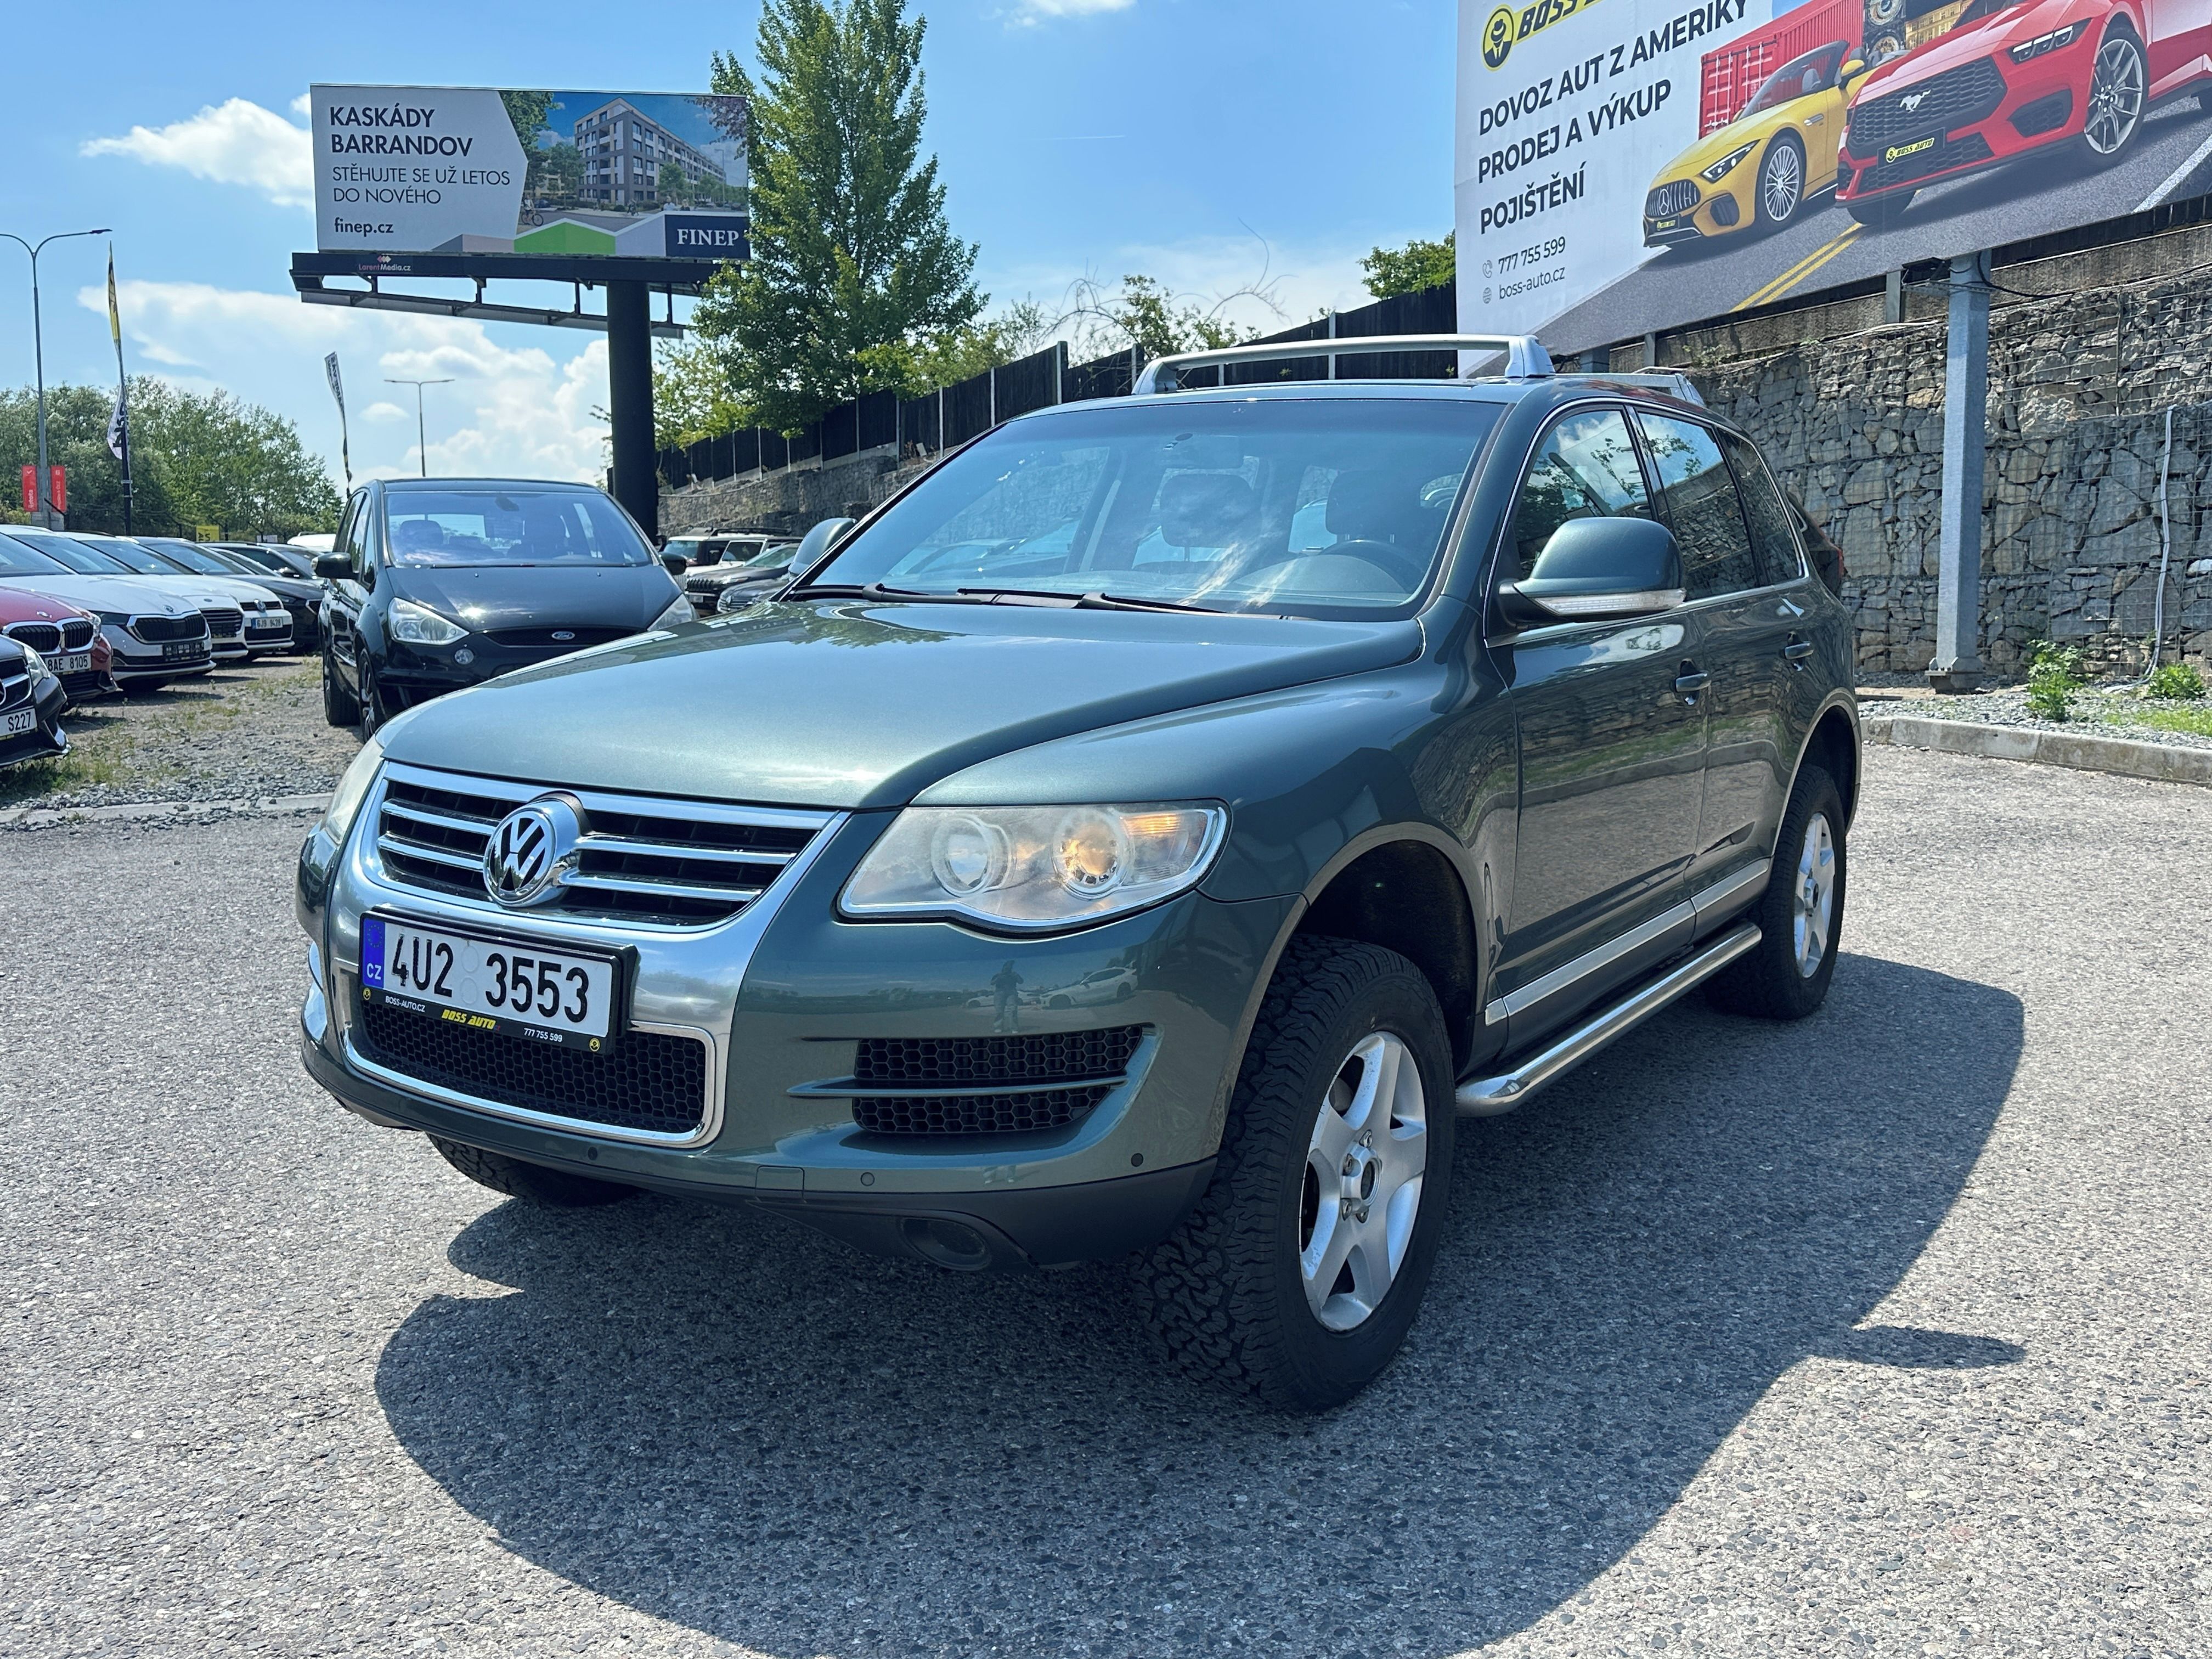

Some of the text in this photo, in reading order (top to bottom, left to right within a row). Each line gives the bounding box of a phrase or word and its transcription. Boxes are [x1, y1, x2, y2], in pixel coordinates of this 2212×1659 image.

[1480, 0, 1745, 136] DOVOZ AUT Z AMERIKY
[330, 103, 435, 127] KASKÁDY
[1479, 79, 1671, 184] PRODEJ A VÝKUP
[331, 134, 473, 156] BARRANDOV
[332, 163, 510, 185] STĚHUJTE SE UŽ LETOS
[334, 185, 441, 204] DO NOVÉHO
[1481, 161, 1587, 235] POJIŠTĚNÍ
[335, 217, 394, 237] finep.cz
[677, 229, 739, 246] FINEP
[1498, 236, 1565, 274] 777 755 599
[1499, 267, 1565, 300] boss-auto.cz
[48, 655, 88, 672] 8AE 8105
[8, 712, 31, 731] S227
[366, 934, 589, 1023] CZ 4U2 3553
[385, 996, 426, 1013] BOSS-AUTO.CZ
[441, 1009, 467, 1023] BOSS
[467, 1015, 496, 1030] AUTO
[523, 1028, 562, 1042] 777 755 599
